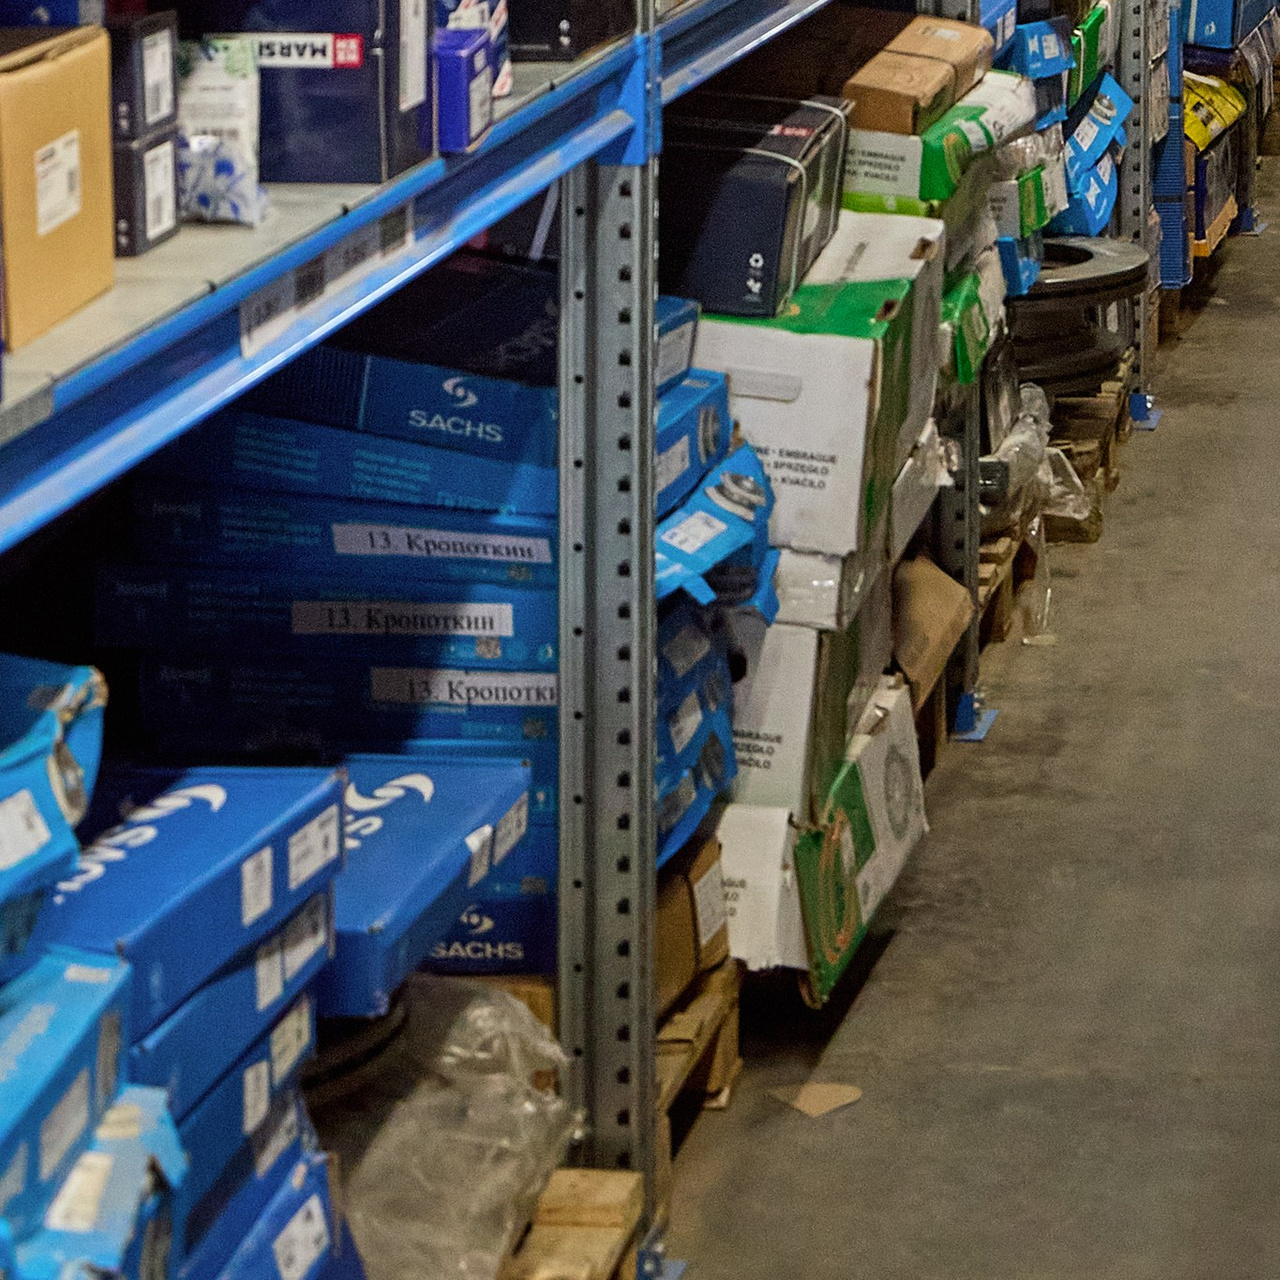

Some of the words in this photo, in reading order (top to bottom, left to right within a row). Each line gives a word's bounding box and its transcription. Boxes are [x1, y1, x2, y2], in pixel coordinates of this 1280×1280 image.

[409, 409, 503, 442] SACHS
[406, 532, 535, 559] Кропоткин
[366, 608, 495, 636] Кропоткин
[431, 941, 524, 959] SACHS
